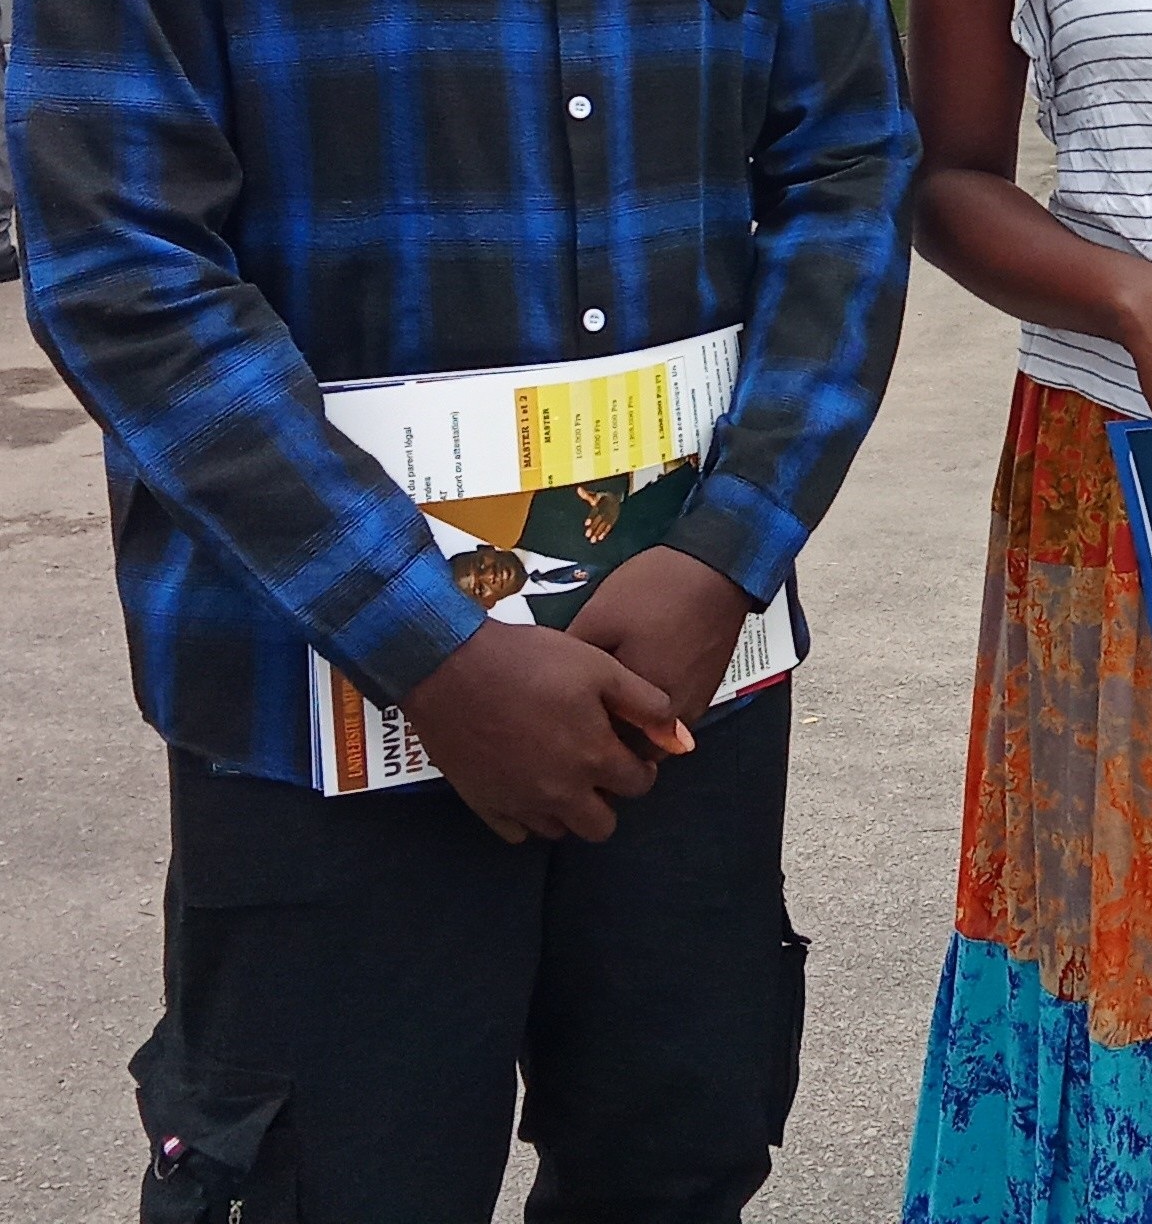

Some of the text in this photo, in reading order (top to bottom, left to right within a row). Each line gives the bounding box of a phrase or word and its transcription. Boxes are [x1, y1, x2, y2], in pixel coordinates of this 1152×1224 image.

[403, 426, 414, 449] légal
[542, 407, 551, 444] MASTER
[521, 425, 532, 468] MASTER
[406, 449, 417, 477] parent
[455, 461, 463, 473] ou
[407, 482, 416, 491] du
[382, 707, 402, 777] UNIVE
